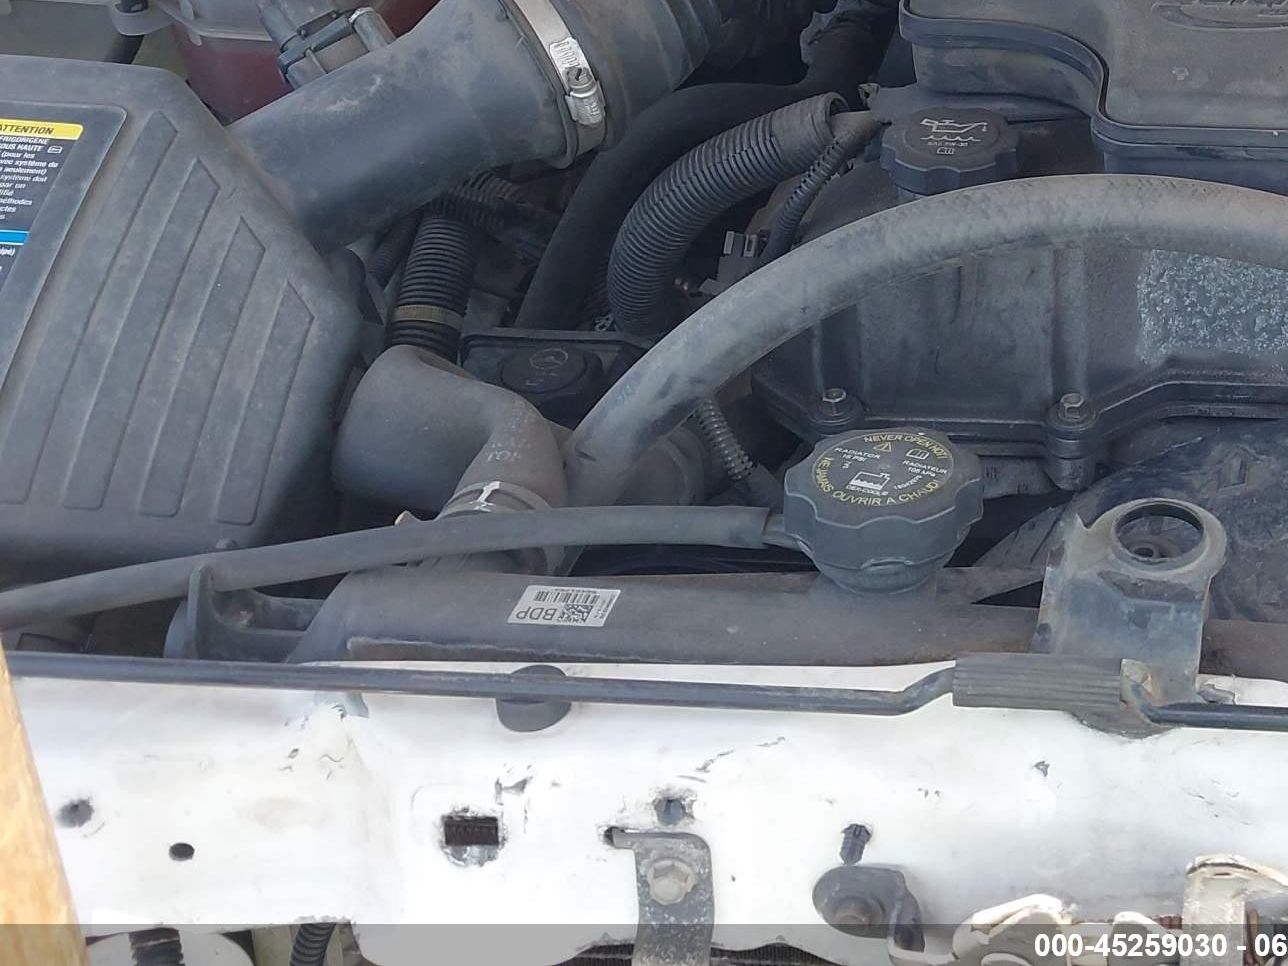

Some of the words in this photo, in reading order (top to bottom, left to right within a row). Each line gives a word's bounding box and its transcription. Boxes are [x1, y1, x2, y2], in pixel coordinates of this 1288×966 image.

[0, 143, 17, 152] OUS
[17, 143, 44, 152] HAUTE
[864, 433, 902, 443] NEVER
[904, 434, 932, 448] OPEN
[834, 447, 881, 459] RADIATOR
[902, 459, 948, 475] RADIATEUR
[832, 490, 881, 506] OUVRIR
[515, 606, 558, 621] BDP
